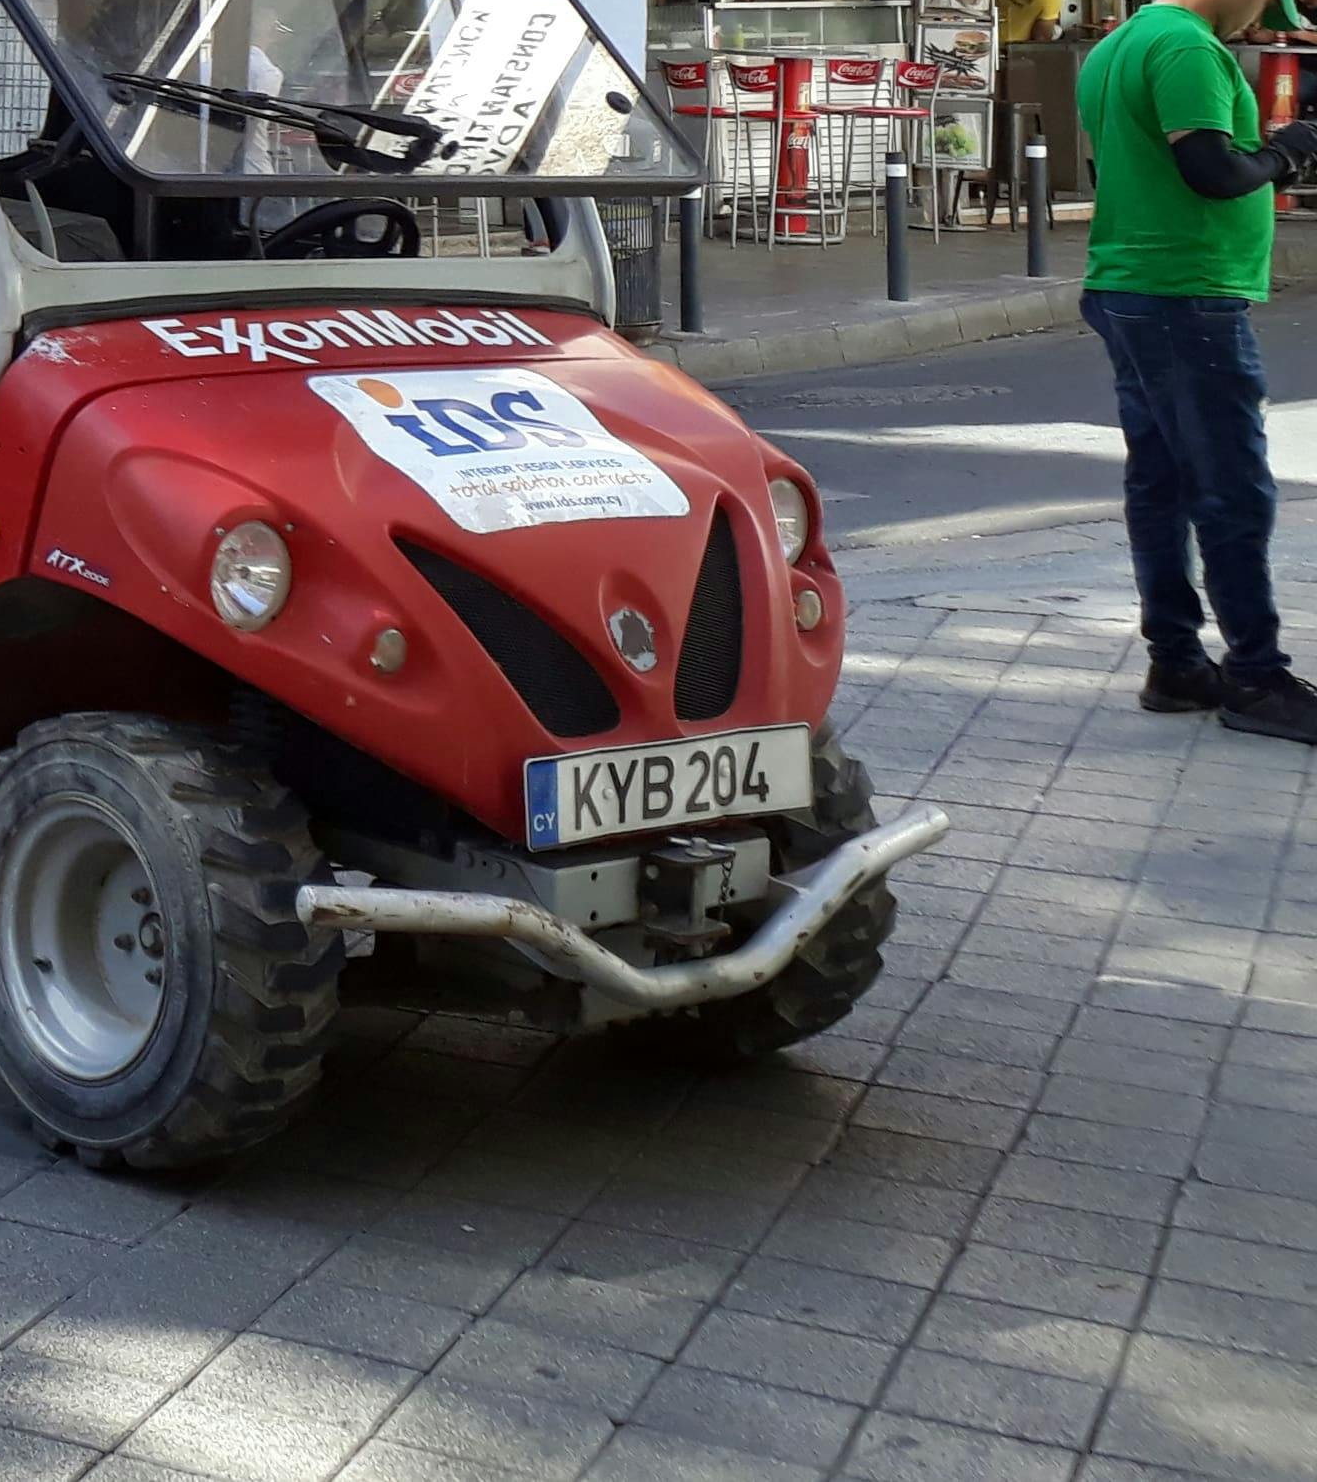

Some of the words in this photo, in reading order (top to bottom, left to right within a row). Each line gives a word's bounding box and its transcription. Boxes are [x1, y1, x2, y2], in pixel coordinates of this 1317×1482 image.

[141, 309, 555, 365] ExxonMobil
[455, 465, 515, 479] INTERIOR
[565, 458, 623, 468] SERVICES
[450, 478, 502, 498] total
[46, 549, 85, 574] ATX
[574, 756, 675, 830] KYB
[685, 742, 769, 814] 204
[534, 812, 557, 832] CY
